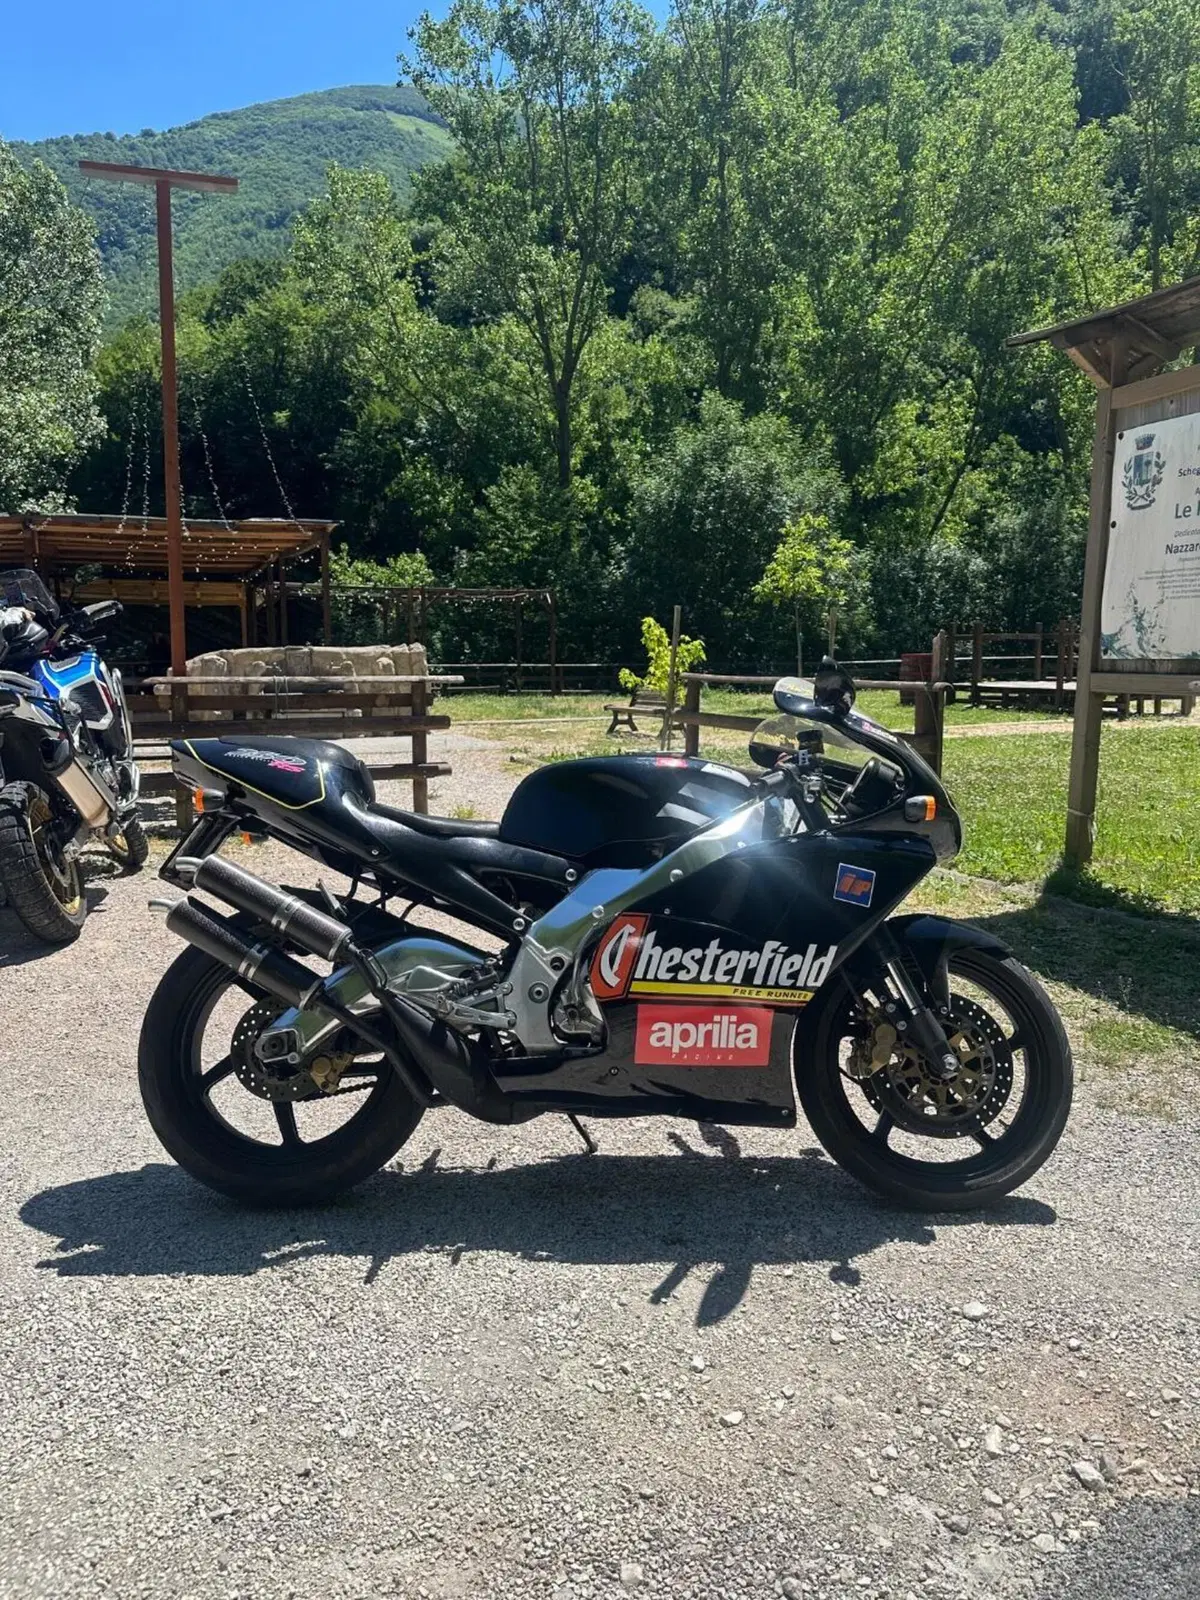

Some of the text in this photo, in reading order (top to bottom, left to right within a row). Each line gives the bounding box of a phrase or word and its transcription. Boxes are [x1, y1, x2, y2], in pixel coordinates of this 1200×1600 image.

[1175, 503, 1192, 519] Le
[1165, 543, 1200, 554] Nazzar
[600, 923, 838, 988] Chesterfield
[733, 988, 762, 996] FREE
[650, 1014, 758, 1053] aprilia
